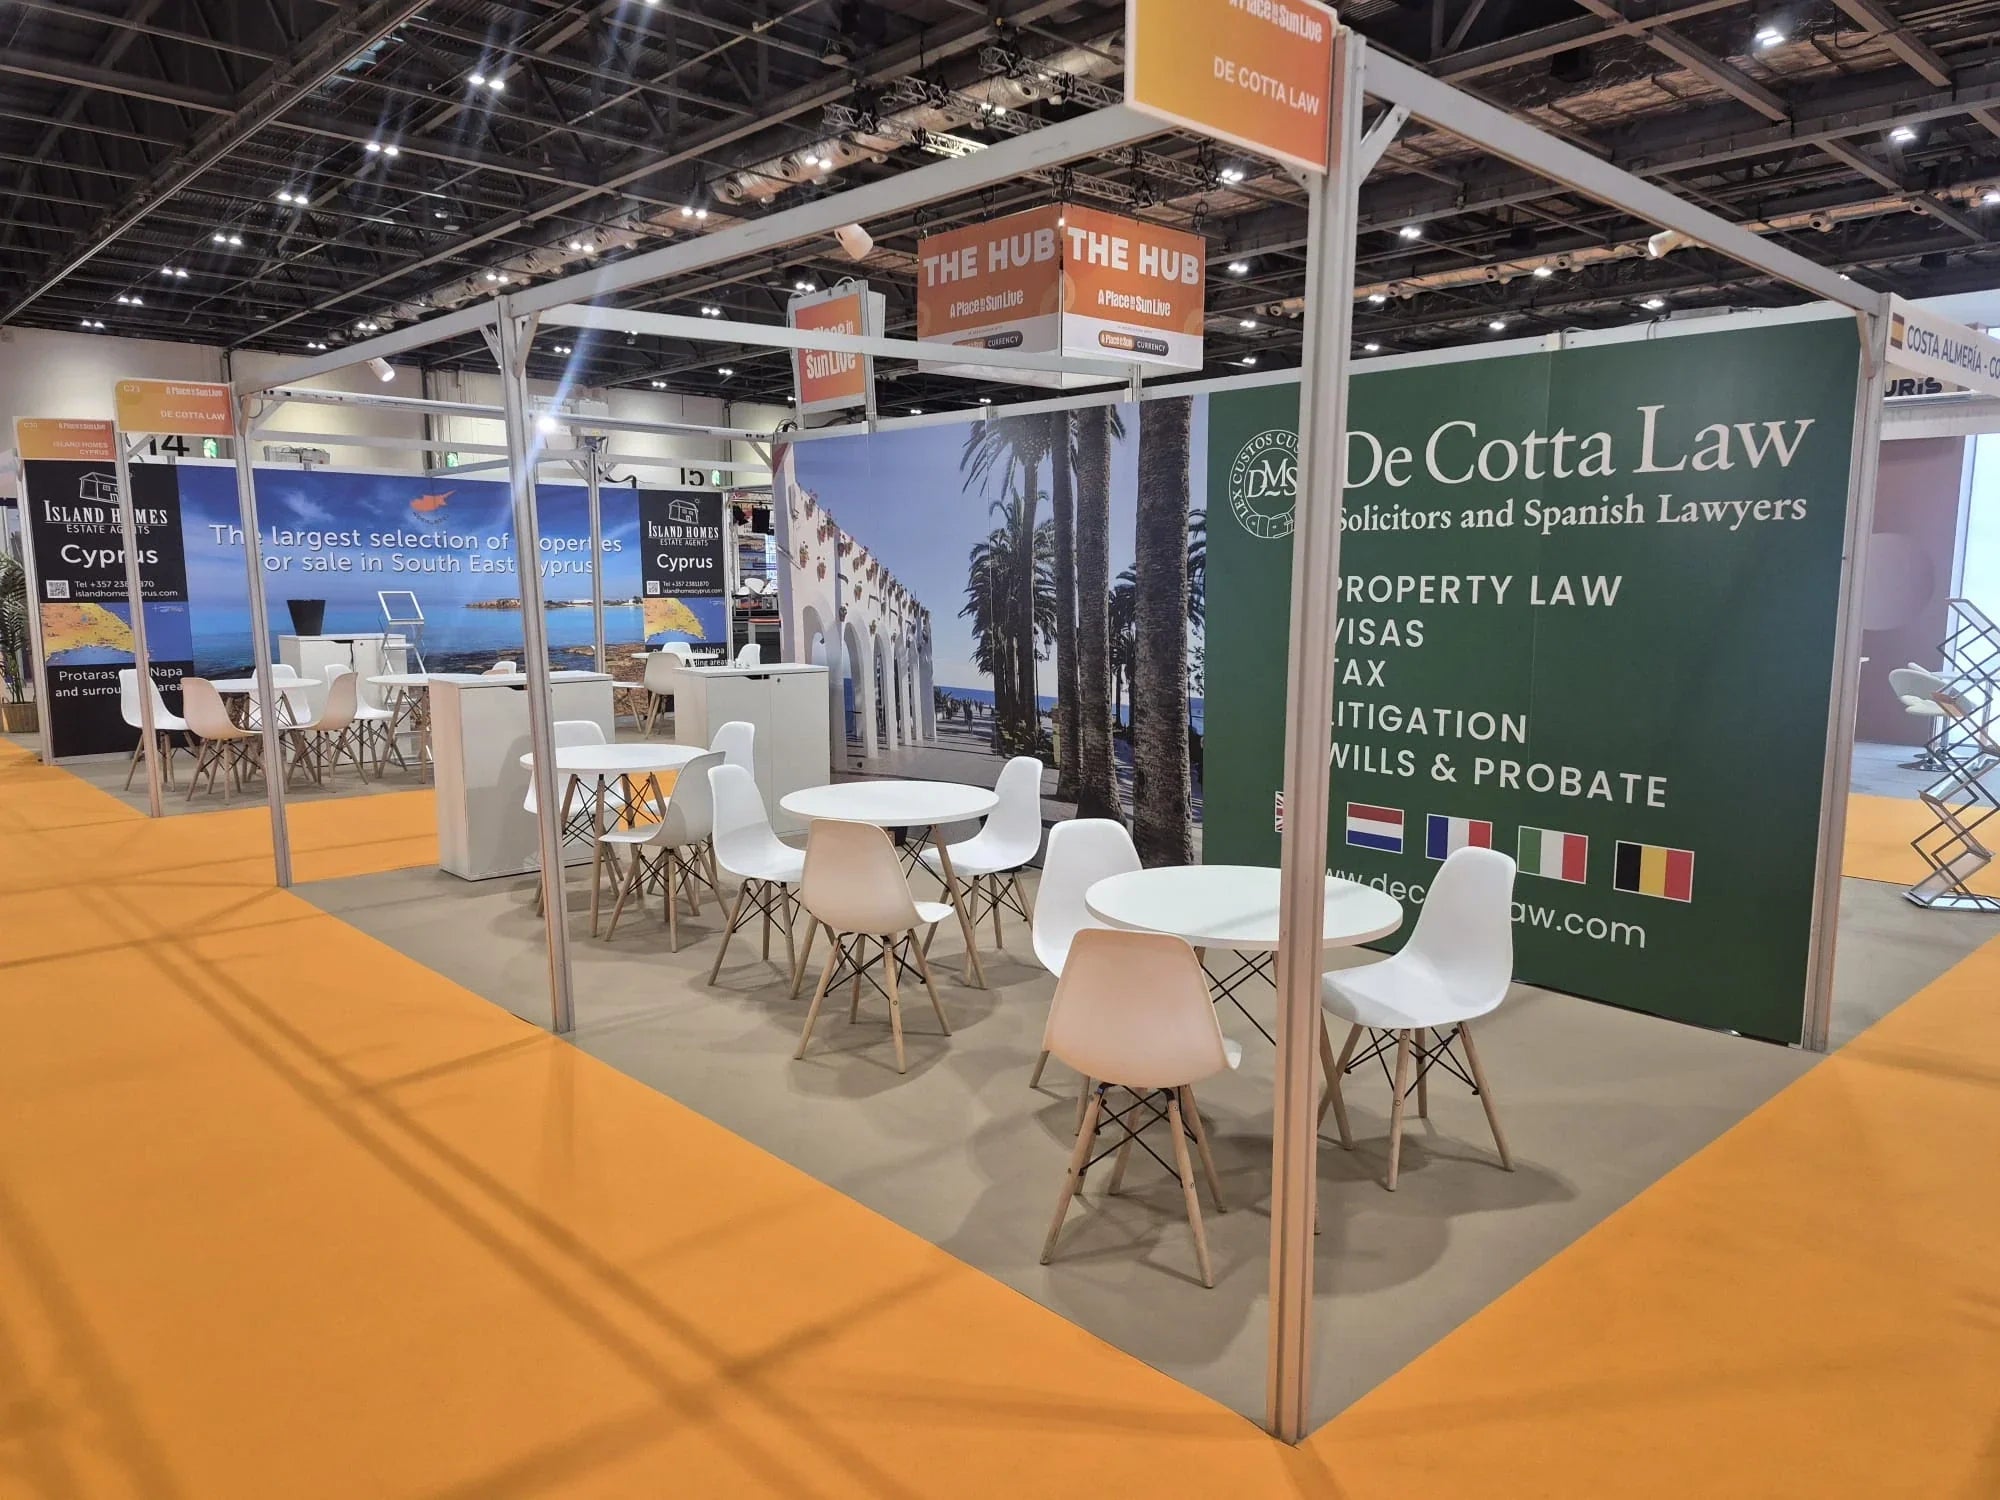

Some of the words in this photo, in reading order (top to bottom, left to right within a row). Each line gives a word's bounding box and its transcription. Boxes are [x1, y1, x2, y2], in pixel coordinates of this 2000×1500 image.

[1280, 5, 1300, 35] Sun
[1301, 14, 1322, 42] Live
[1214, 56, 1234, 83] DE
[1239, 68, 1286, 104] COTTA
[1290, 88, 1319, 115] LAW
[923, 246, 978, 287] THE
[988, 228, 1055, 272] HUB
[1067, 226, 1129, 270] THE
[1139, 244, 1199, 285] HUB
[950, 304, 956, 319] A
[956, 300, 979, 318] Place
[986, 294, 1002, 311] Sun
[1003, 290, 1024, 308] Live
[1098, 289, 1104, 304] A
[1106, 290, 1130, 308] Place
[1136, 296, 1152, 314] Sun
[1153, 299, 1170, 316] Live
[988, 336, 1018, 348] CURRENCY
[1136, 340, 1166, 352] CURRENCY
[1907, 325, 1940, 360] COSTA
[1941, 338, 1982, 374] ALMERÍA
[806, 354, 829, 379] Sun
[160, 410, 173, 418] DE
[176, 411, 204, 420] COTTA
[206, 412, 226, 420] LAW
[1232, 434, 1272, 484] CUSTOS
[1342, 431, 1412, 488] De
[1426, 420, 1616, 484] Cotta
[1632, 404, 1816, 473] Law
[44, 500, 104, 522] ISLAND
[112, 508, 168, 524] HMES
[1232, 488, 1249, 518] LEX
[1460, 498, 1514, 528] and
[1524, 493, 1645, 535] Spanish
[1656, 494, 1807, 531] Lawyers
[66, 524, 105, 534] ESTATE
[110, 525, 150, 535] AGTS
[272, 526, 362, 551] largest
[370, 530, 478, 550] selection
[487, 532, 510, 550] of
[648, 521, 682, 538] ISLAND
[686, 526, 719, 539] HOMES
[261, 552, 292, 571] or
[302, 552, 352, 572] sale
[361, 553, 382, 572] in
[392, 553, 460, 573] South
[470, 554, 516, 574] East
[540, 560, 592, 577] yprus
[657, 554, 713, 572] Cyprus
[76, 590, 178, 598] islandhomesrus.com
[1338, 575, 1513, 605] ROPERTY
[1530, 575, 1622, 606] LAW
[59, 670, 118, 681] Protaras,
[150, 668, 183, 678] Napa
[1334, 658, 1386, 687] AX
[56, 687, 78, 697] and
[1332, 700, 1527, 744] ITIGATION
[1328, 742, 1415, 777] WILLS
[1430, 753, 1458, 783] &
[1474, 757, 1668, 808] PROBATE
